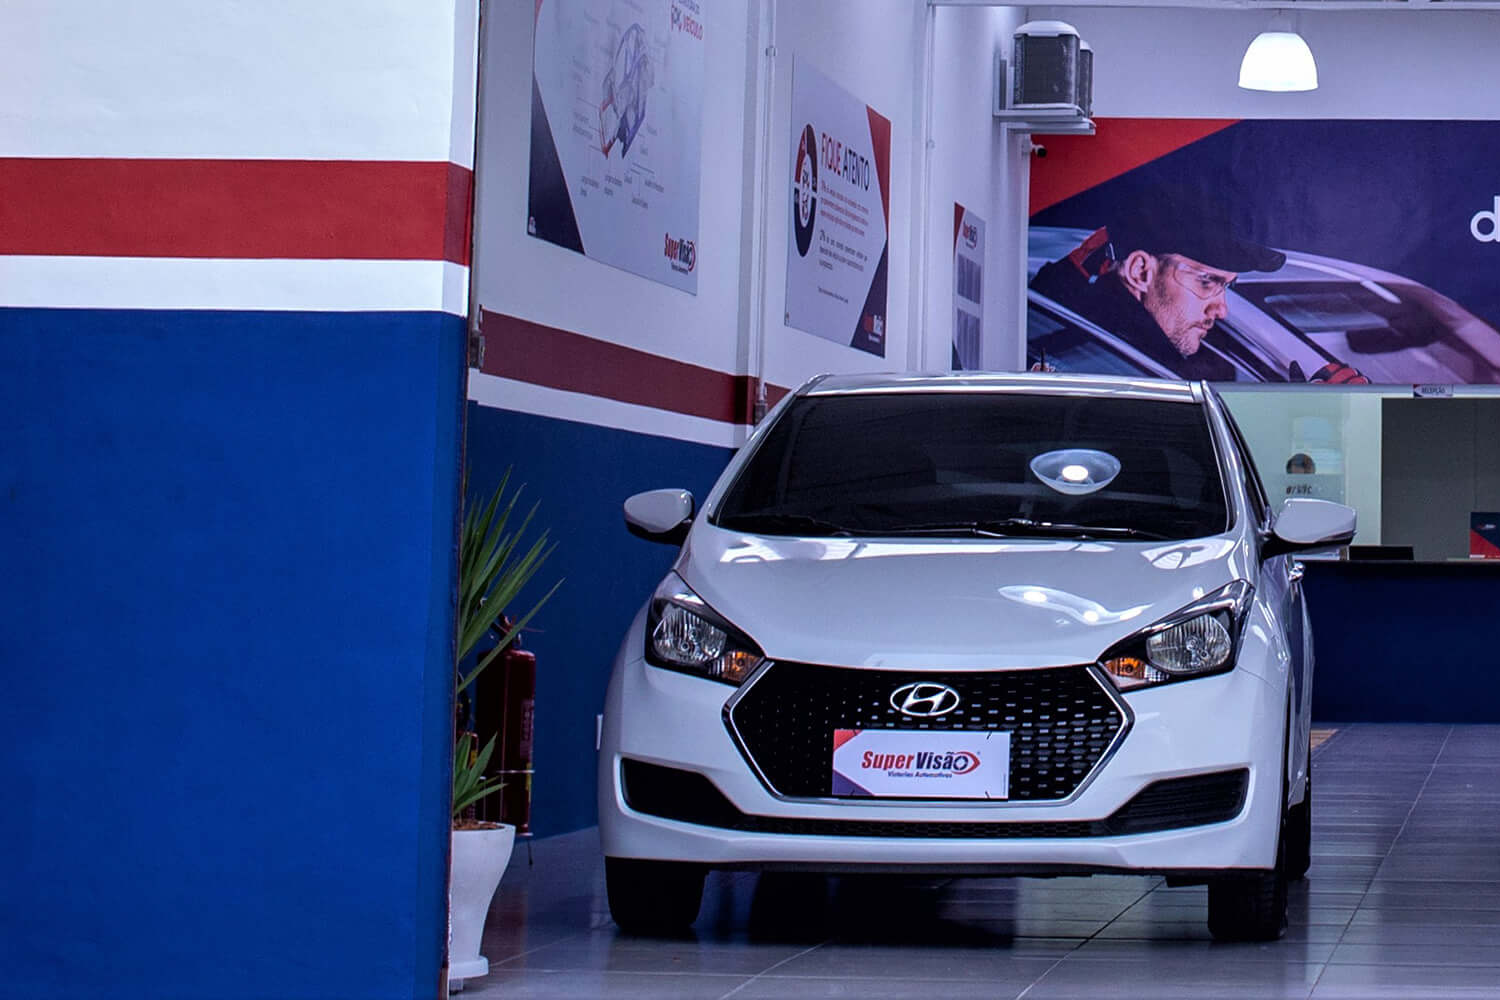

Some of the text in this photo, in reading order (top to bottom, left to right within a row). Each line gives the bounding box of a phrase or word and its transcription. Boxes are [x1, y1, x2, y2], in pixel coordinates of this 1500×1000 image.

[821, 131, 842, 177] FIQUE
[842, 145, 871, 193] ATENTO
[861, 750, 969, 771] Super Visão
